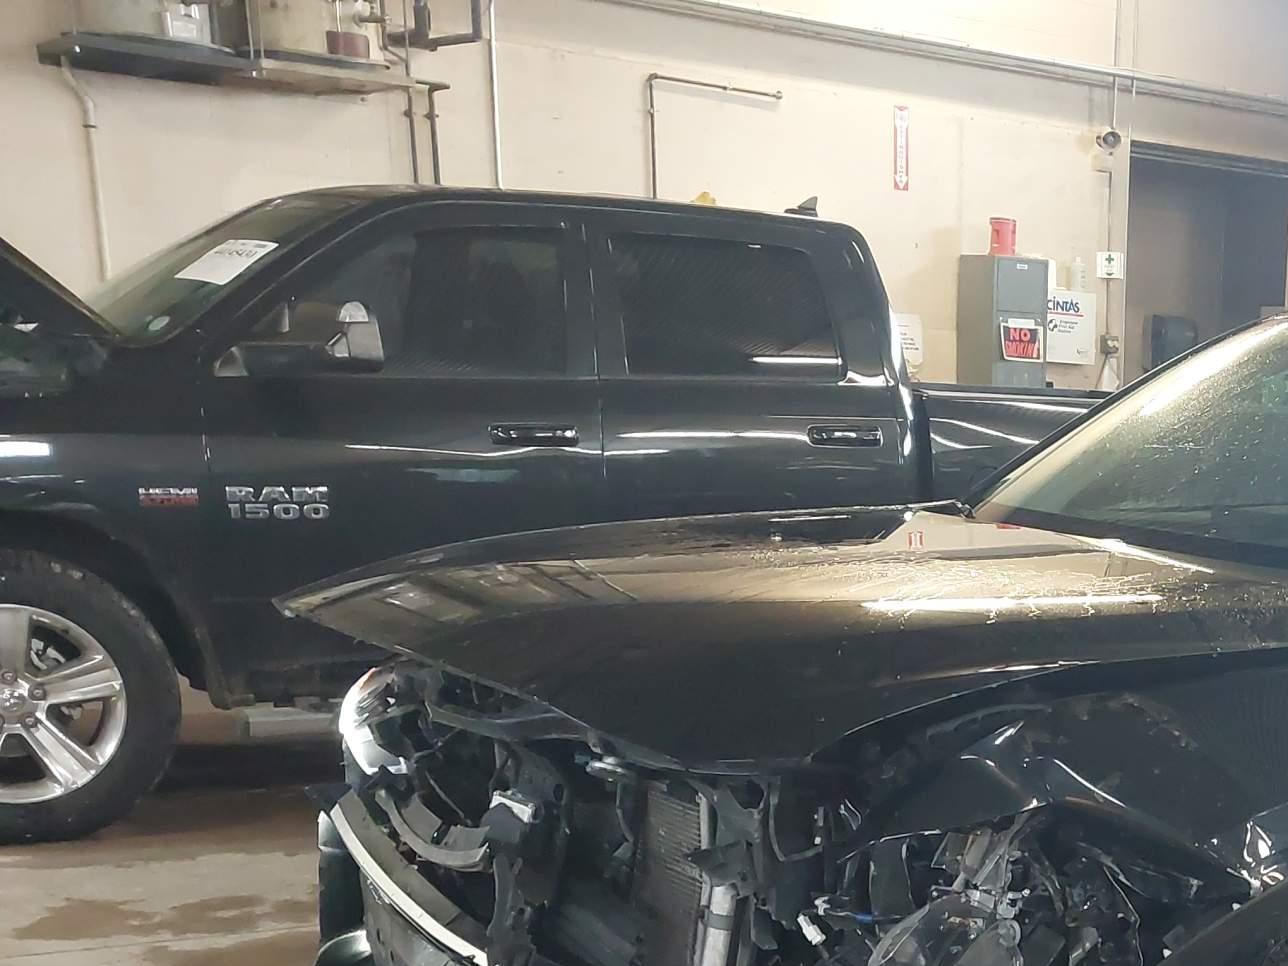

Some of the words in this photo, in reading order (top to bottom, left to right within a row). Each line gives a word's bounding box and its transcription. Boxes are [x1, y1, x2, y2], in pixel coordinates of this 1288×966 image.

[1009, 328, 1031, 342] NO
[225, 486, 328, 502] RAM
[228, 504, 331, 520] 1500
